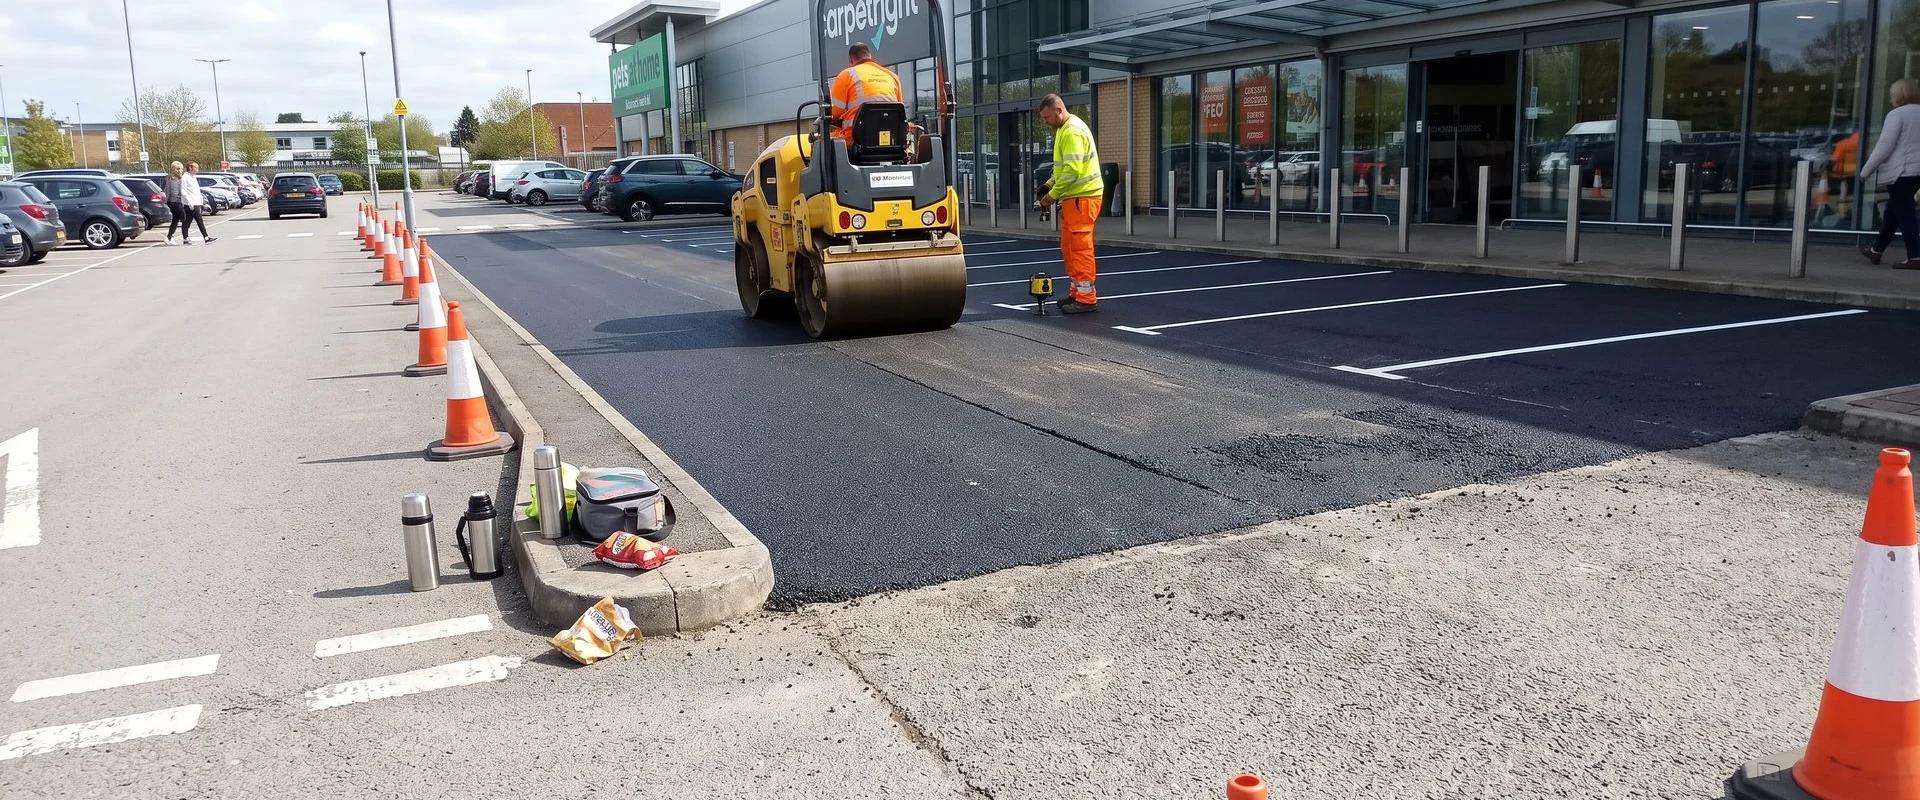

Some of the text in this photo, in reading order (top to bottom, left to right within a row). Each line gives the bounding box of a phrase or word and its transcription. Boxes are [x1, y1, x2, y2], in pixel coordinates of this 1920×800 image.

[823, 0, 919, 46] arpetrig
[612, 49, 661, 98] pets at home
